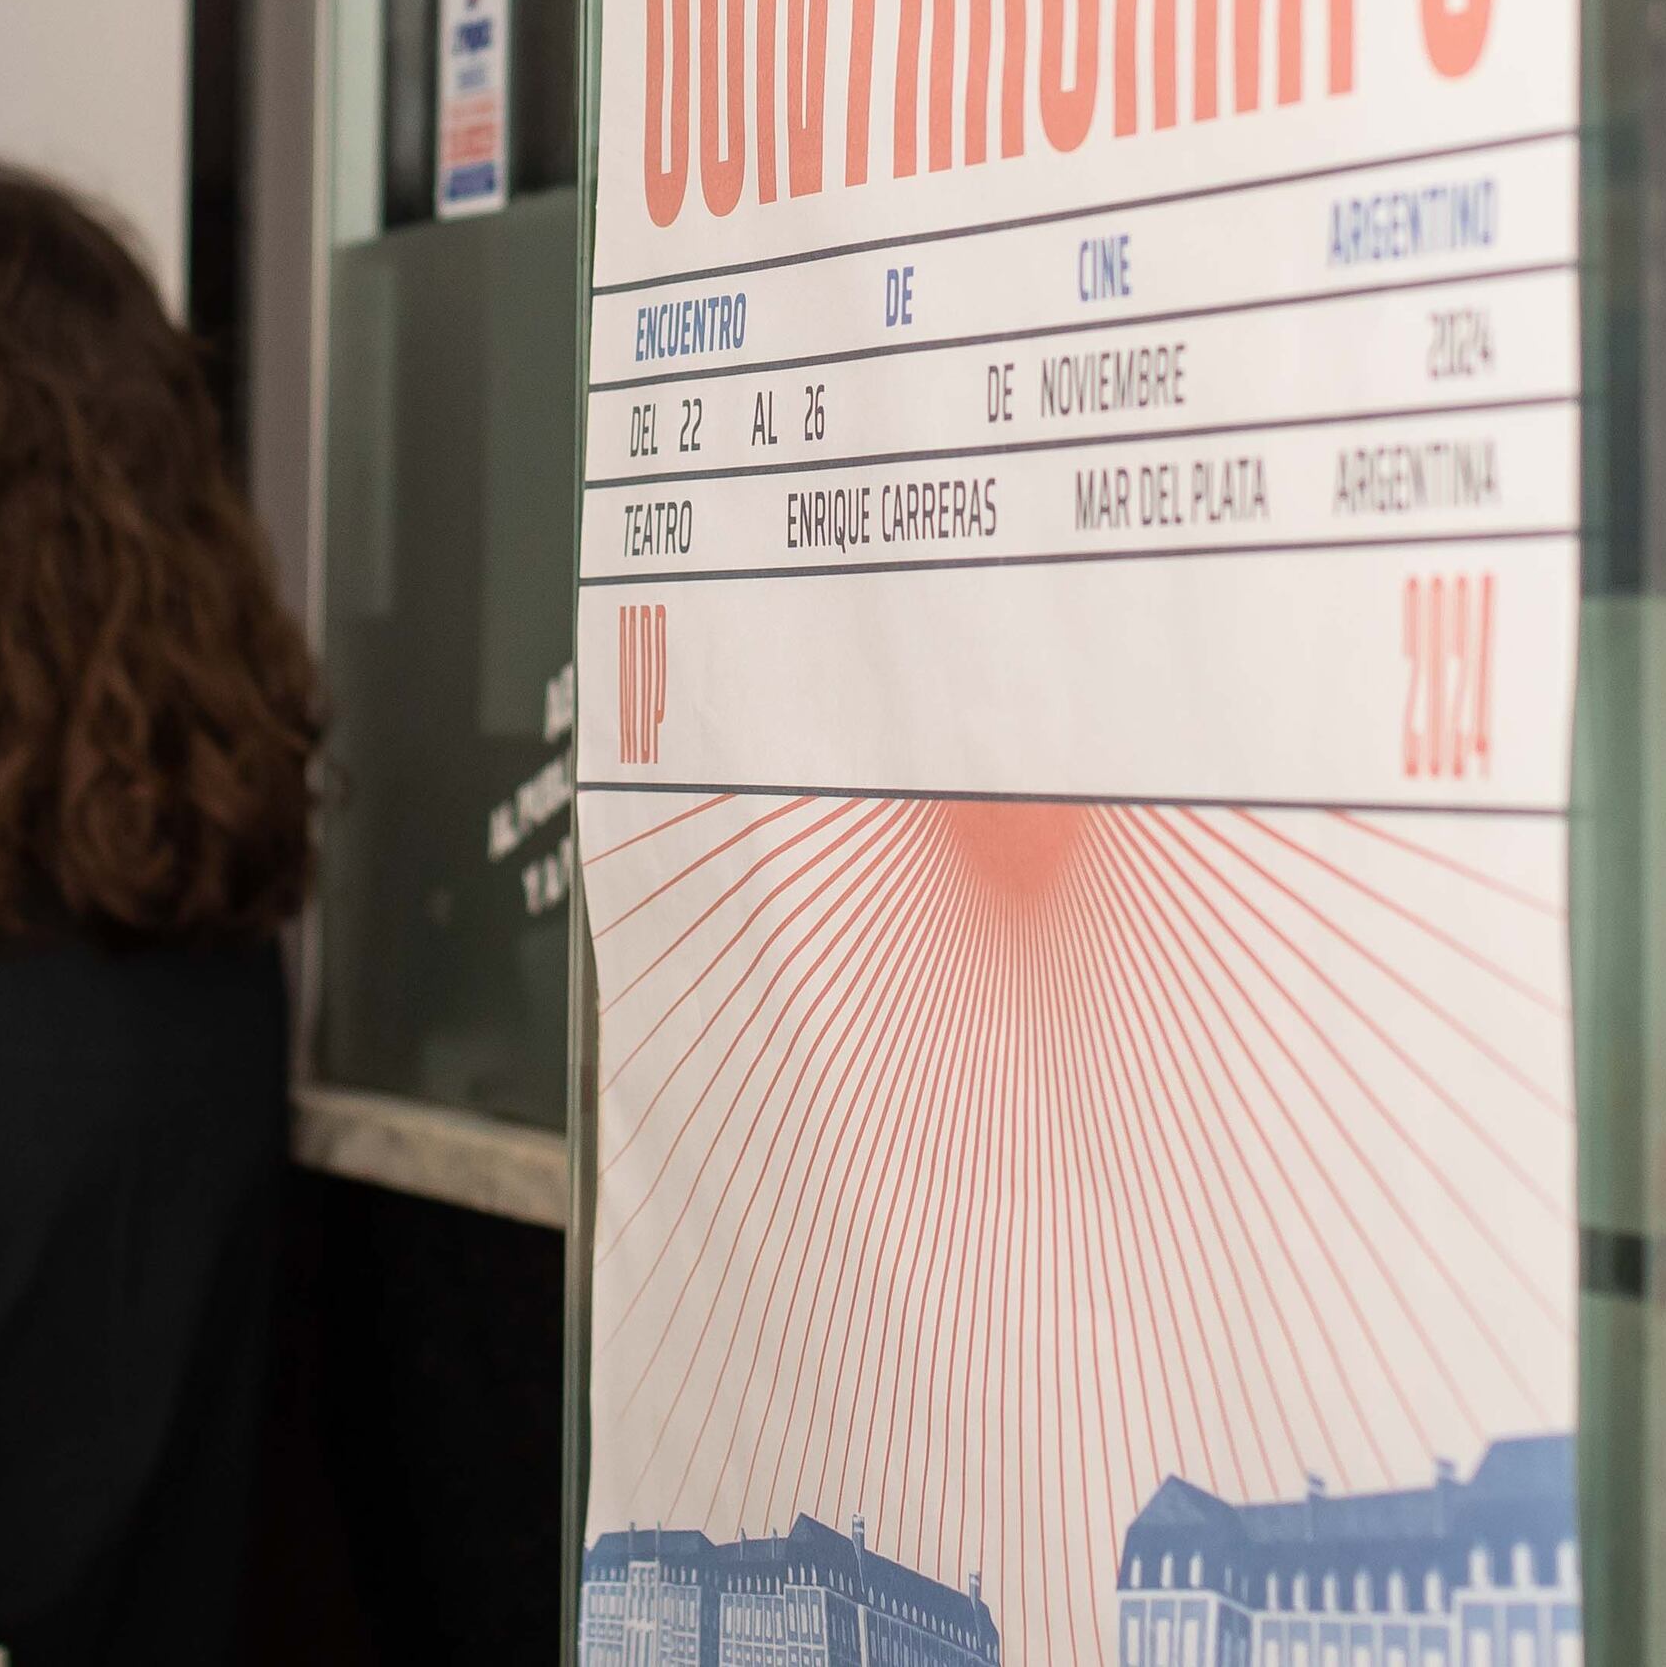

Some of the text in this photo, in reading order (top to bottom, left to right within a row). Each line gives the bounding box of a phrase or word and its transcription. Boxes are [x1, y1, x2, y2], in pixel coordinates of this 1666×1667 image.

[635, 179, 1498, 362] ENCUENTRO DE CINE ARGENTINO
[630, 309, 1495, 457] DEL 22 AL 26 DE NOVIEMBRE 2024
[623, 441, 1500, 557] TEATRO ENRIQUE CARRERAS MAR DEL PLATA ARGENTINA
[619, 604, 667, 764] MDP
[1403, 572, 1497, 779] 2024
